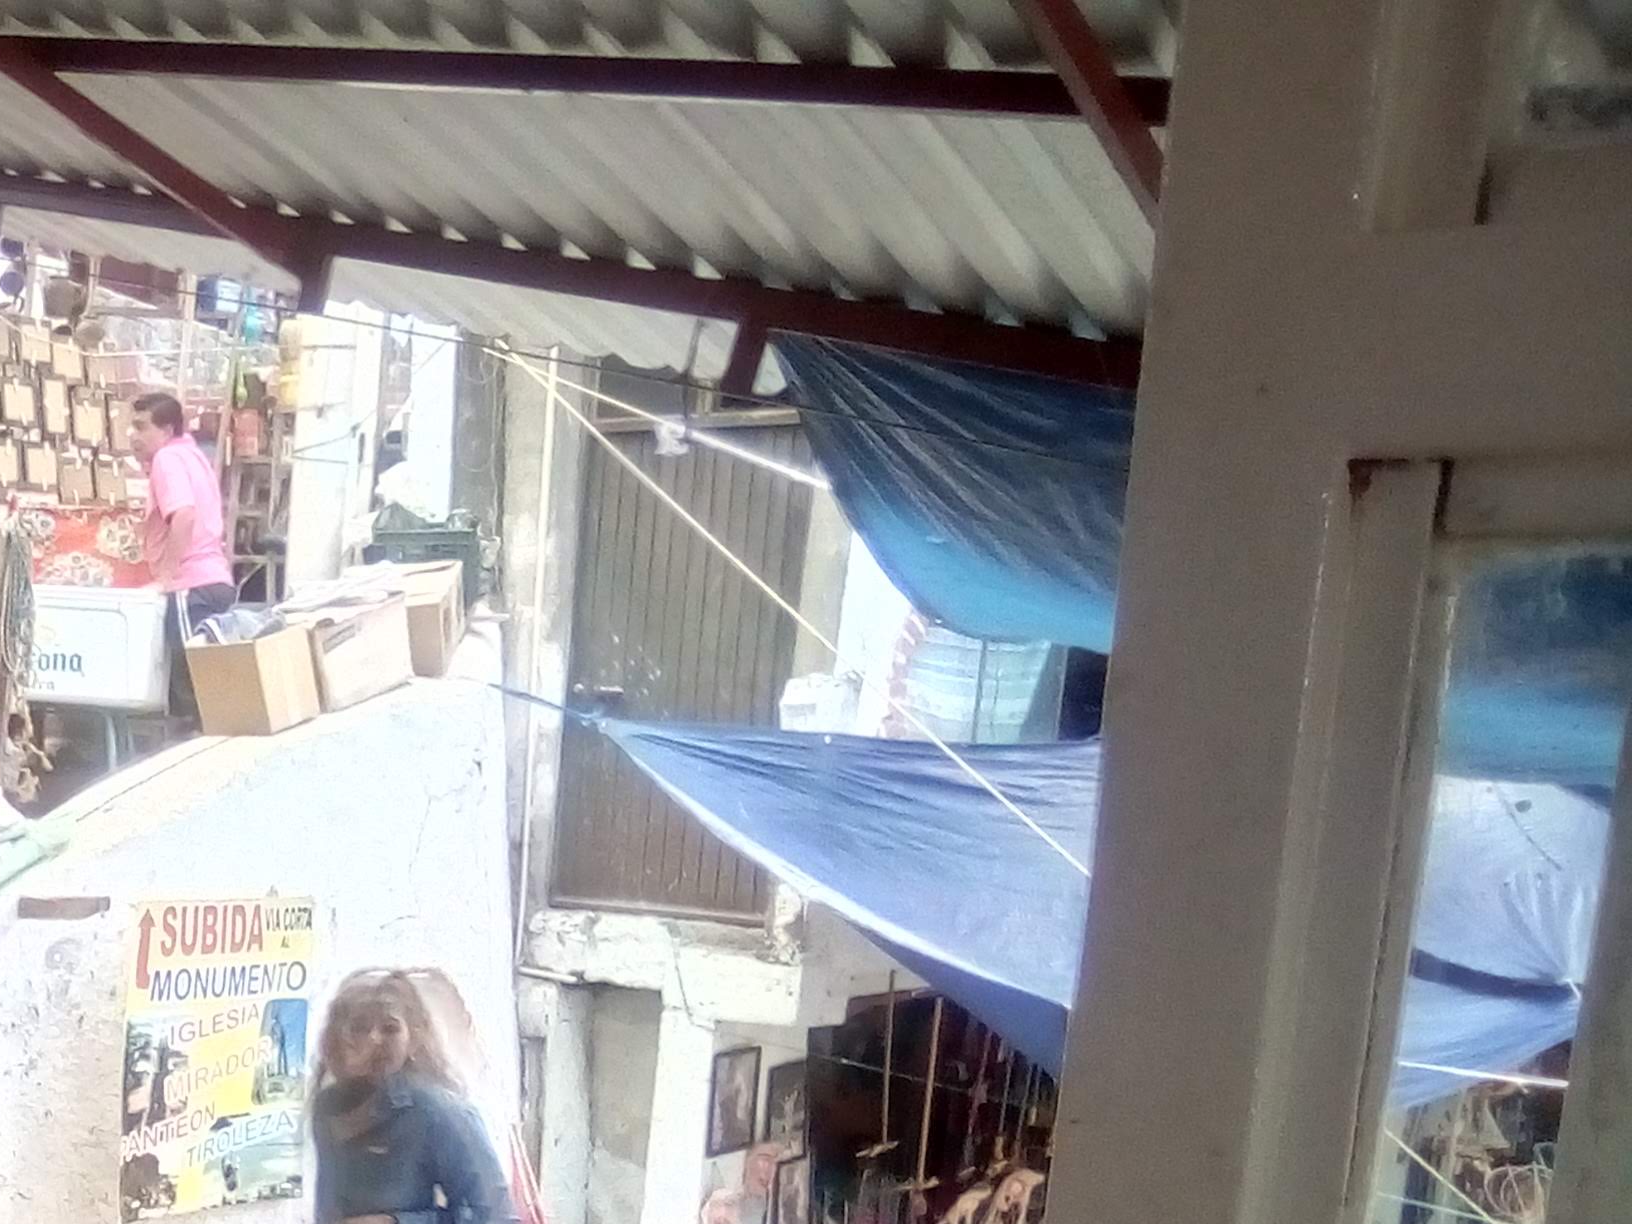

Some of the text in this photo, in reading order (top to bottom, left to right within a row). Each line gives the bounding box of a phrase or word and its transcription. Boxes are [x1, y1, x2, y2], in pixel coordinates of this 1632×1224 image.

[160, 903, 264, 957] SUBIDA
[150, 960, 307, 1001] MONUMENTO
[170, 1003, 260, 1046] IGLESIA
[167, 1039, 270, 1102] MIRADOR
[186, 1111, 294, 1167] TIROLEZA
